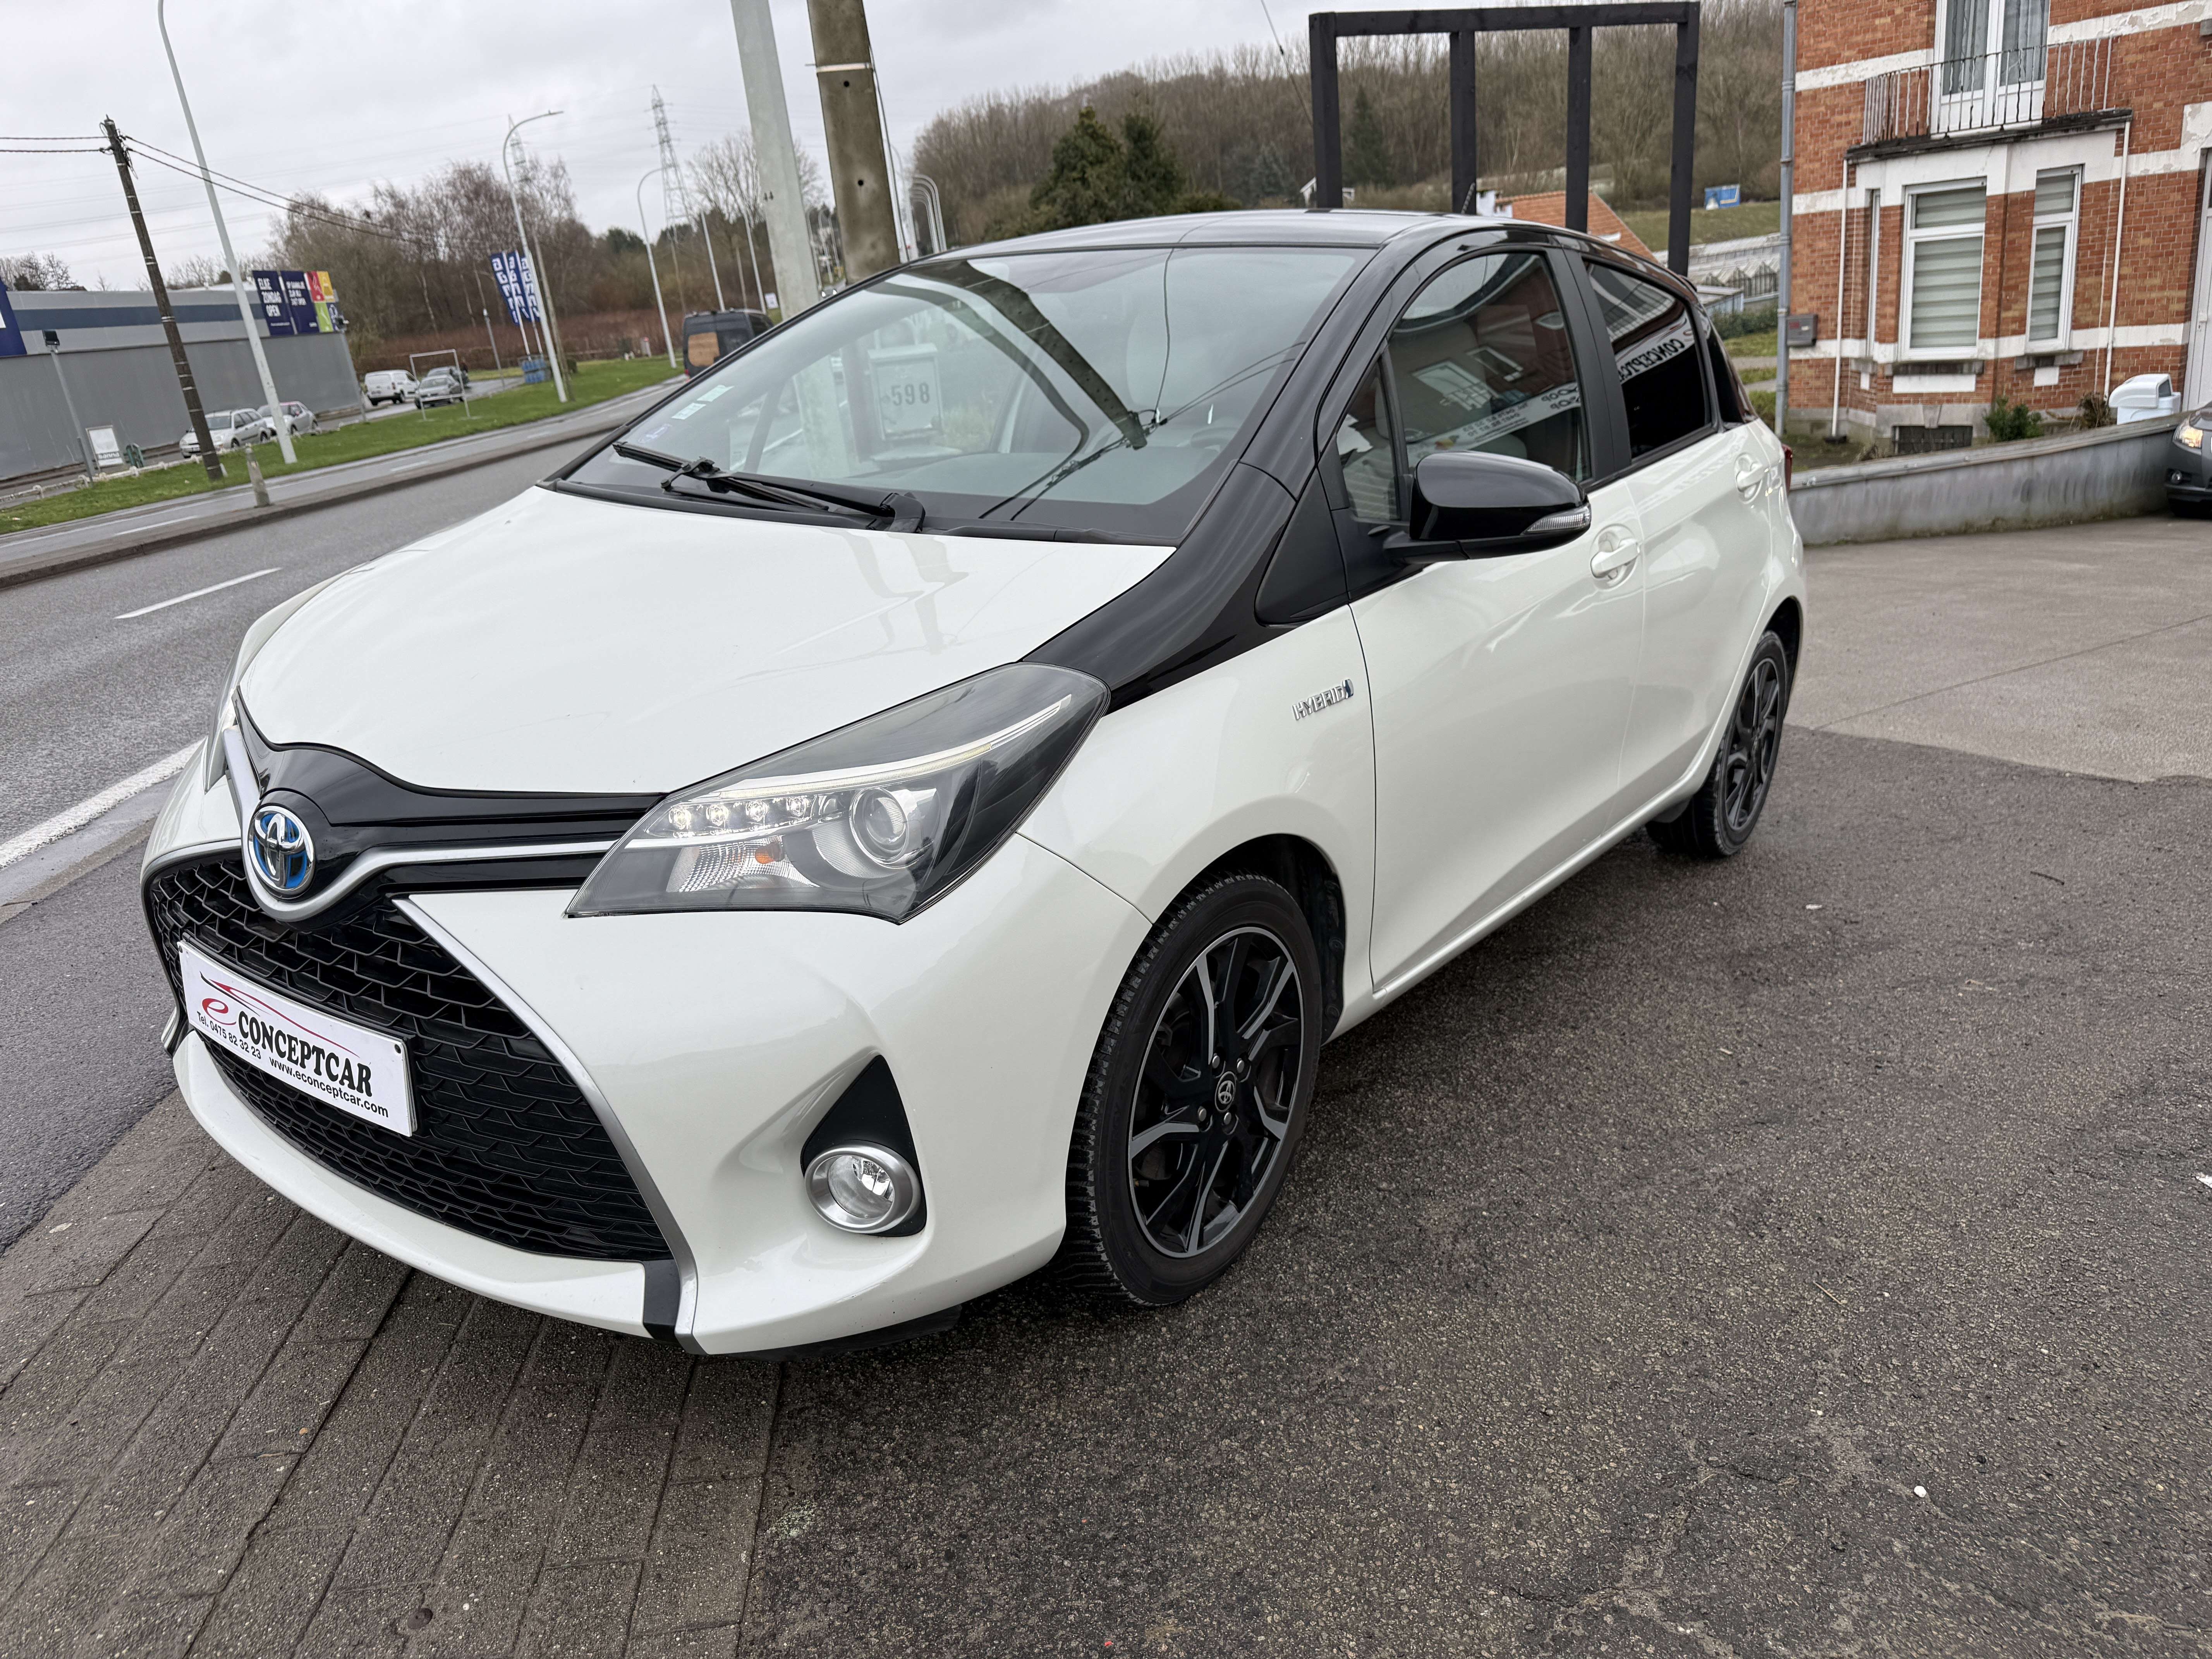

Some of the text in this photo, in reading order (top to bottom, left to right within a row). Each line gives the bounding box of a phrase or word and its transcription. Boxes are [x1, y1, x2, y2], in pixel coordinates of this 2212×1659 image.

[258, 278, 272, 290] ELKE
[261, 291, 282, 304] ZONDAG
[266, 304, 281, 317] OPEN
[892, 383, 930, 406] 598
[1292, 685, 1346, 721] HYBRID
[197, 1012, 261, 1060] Tel. 0475 82 32 23
[239, 1011, 373, 1097] CONCEPTCAR
[270, 1057, 388, 1118] www.econceptcar.com
